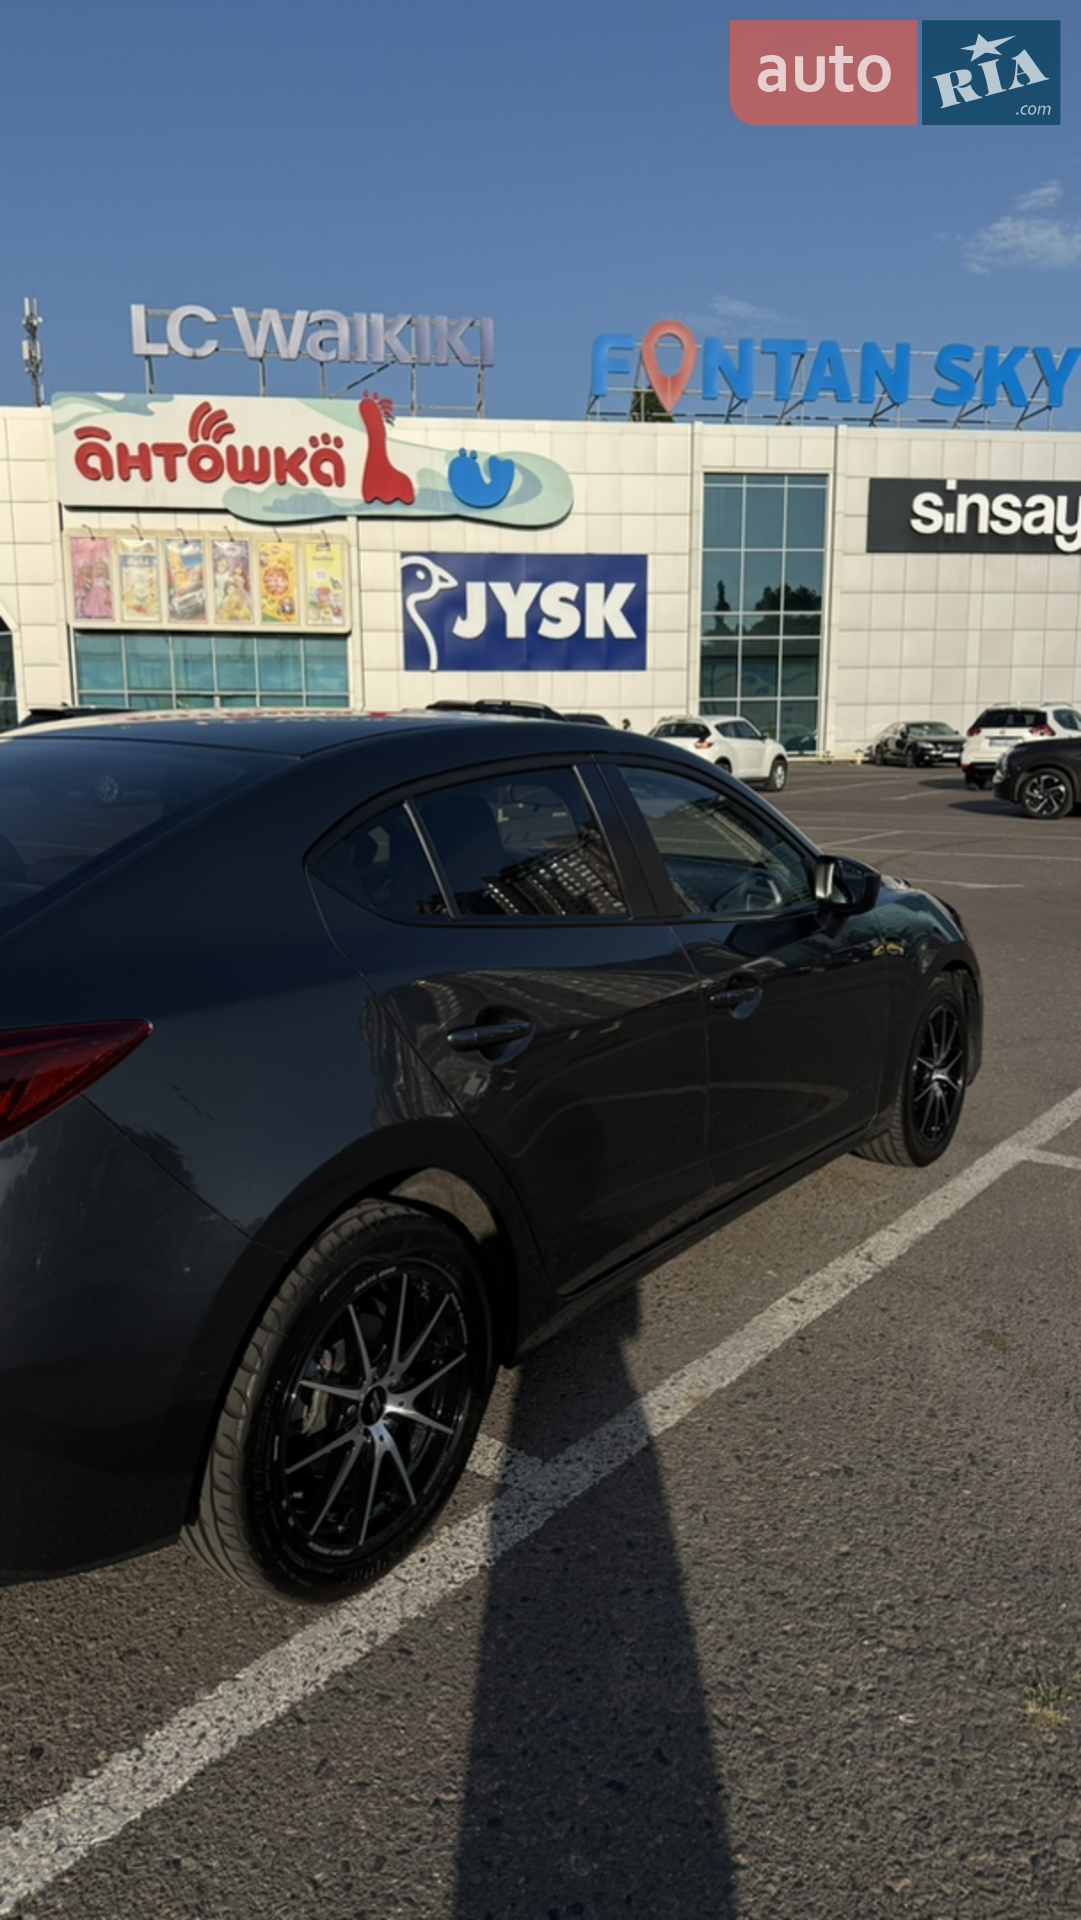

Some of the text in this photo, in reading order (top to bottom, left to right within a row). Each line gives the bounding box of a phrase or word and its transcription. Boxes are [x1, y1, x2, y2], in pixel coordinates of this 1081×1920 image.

[130, 304, 219, 359] LC
[932, 342, 1081, 408] SKY
[910, 479, 1081, 554] sinsay
[451, 580, 637, 640] JYSK
